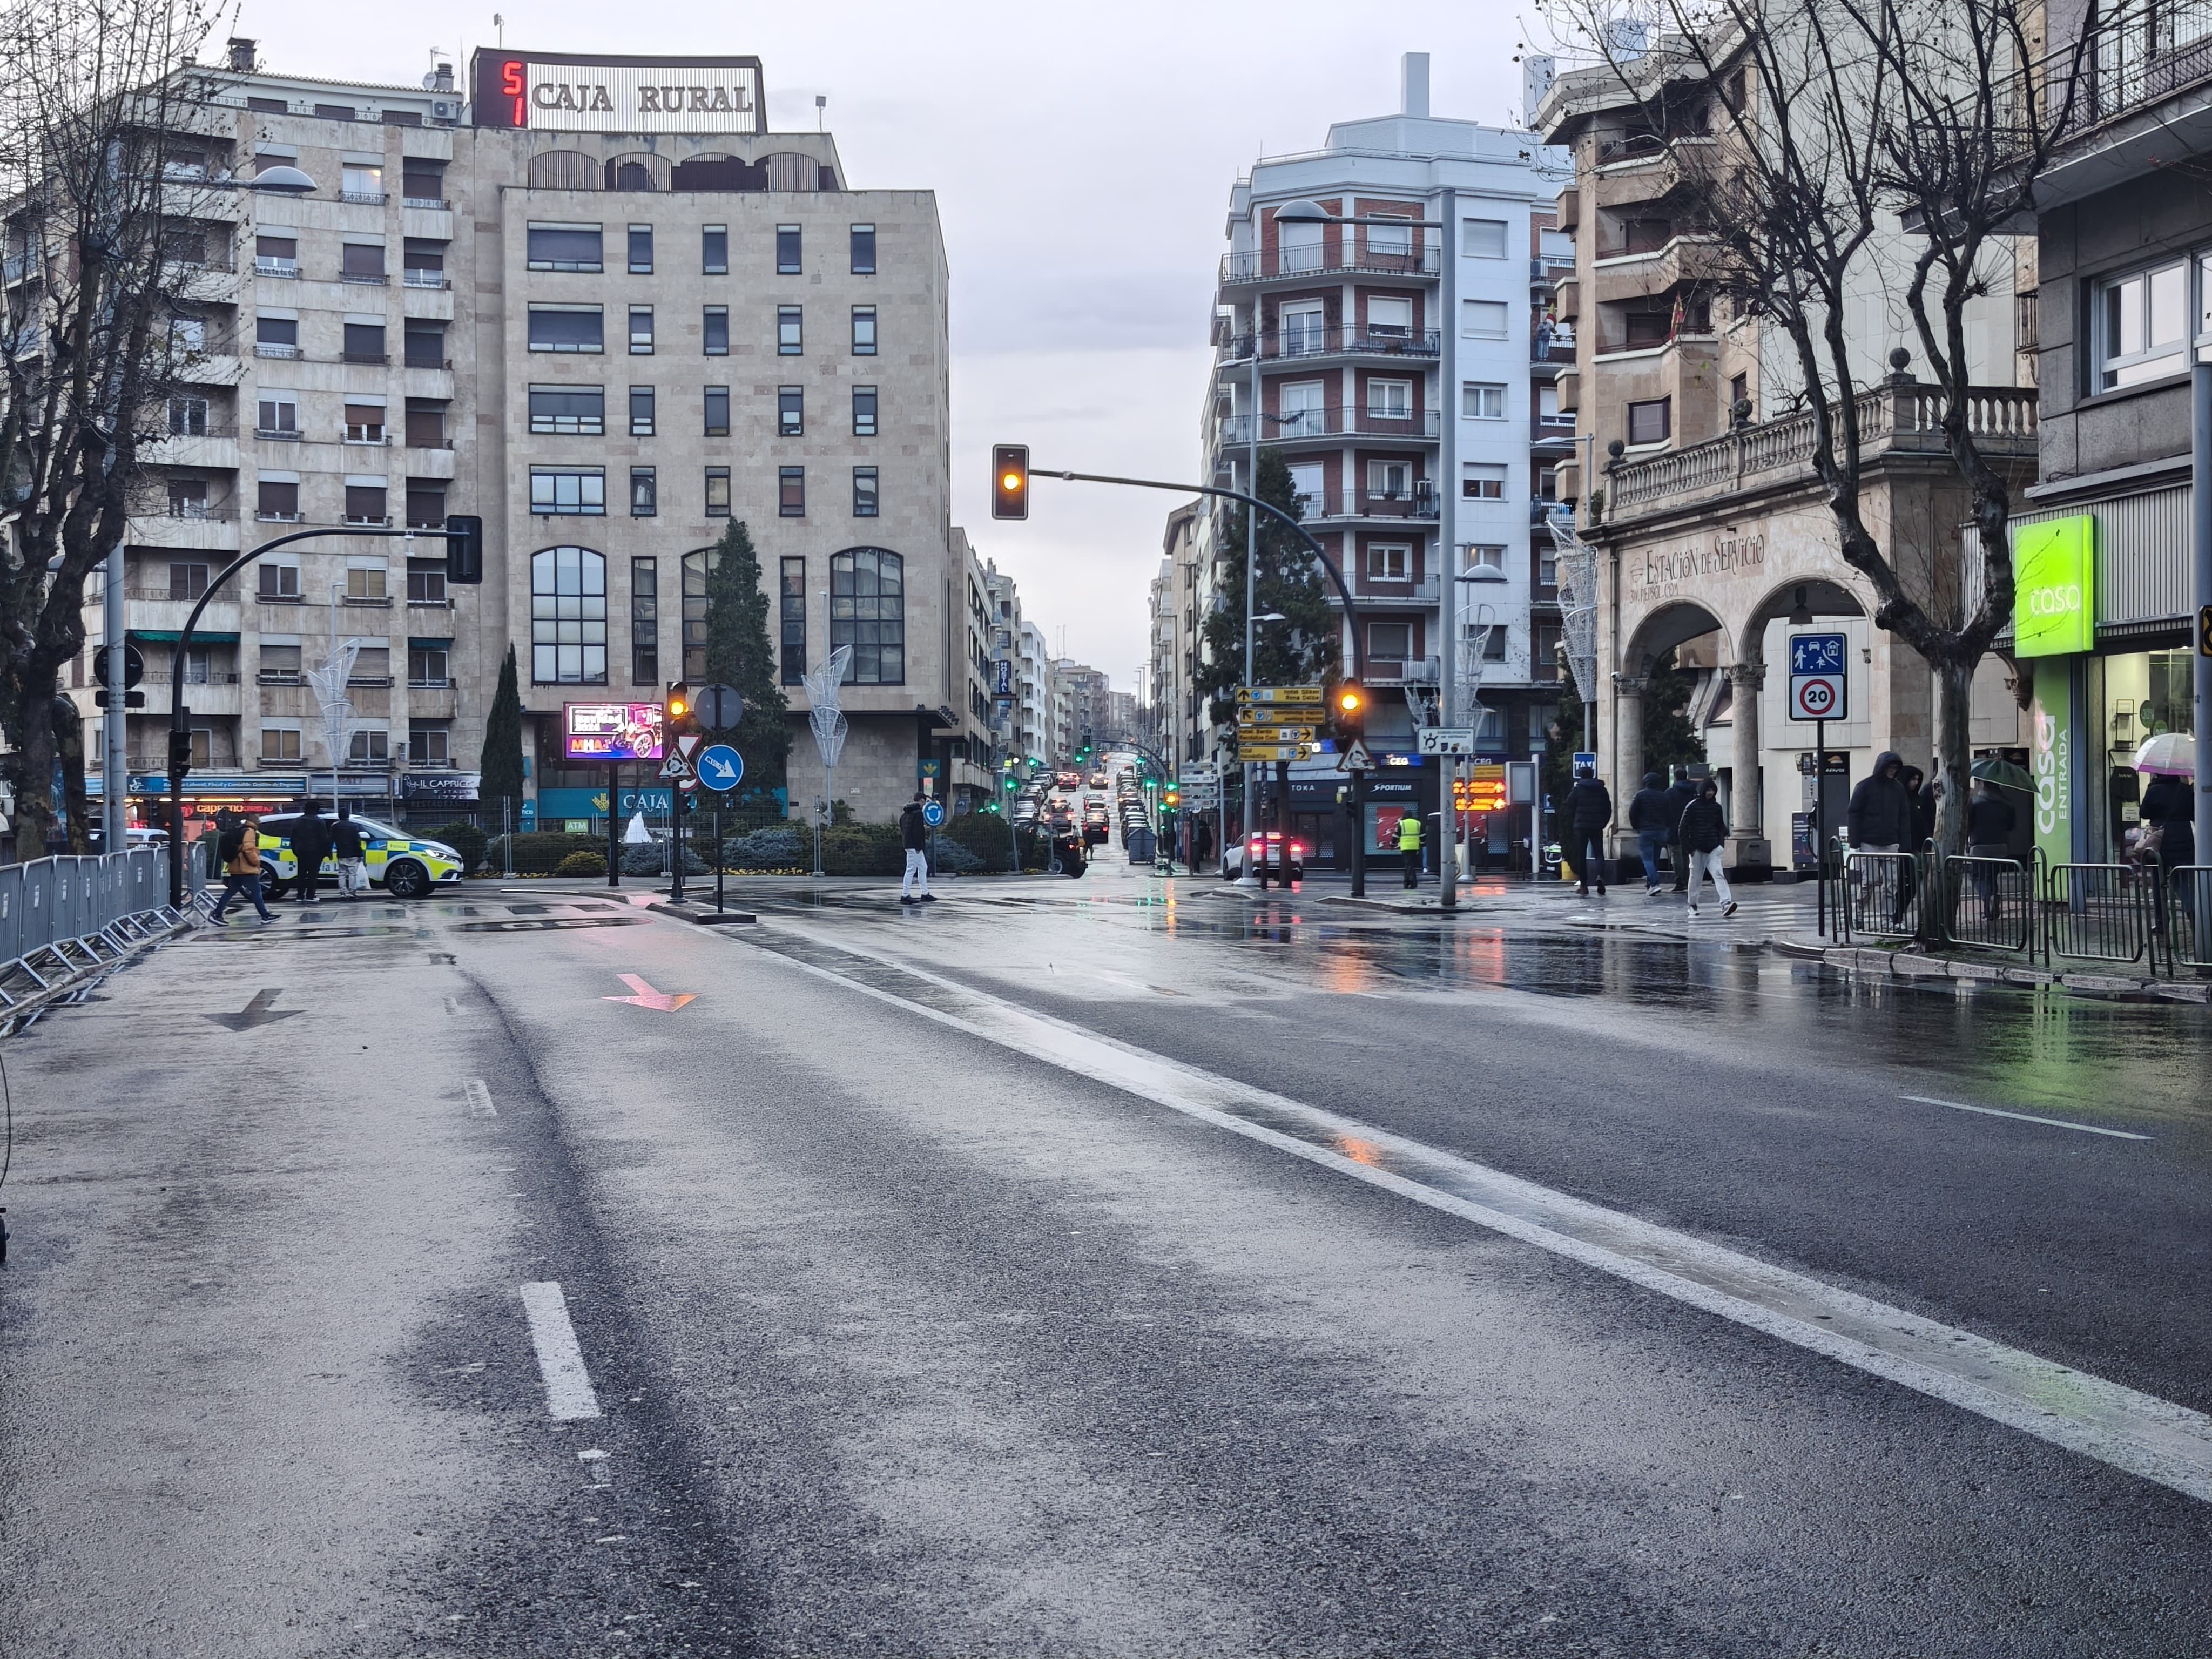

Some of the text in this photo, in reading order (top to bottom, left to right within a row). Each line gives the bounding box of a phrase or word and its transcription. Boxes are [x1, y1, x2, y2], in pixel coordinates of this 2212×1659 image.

[532, 83, 754, 113] CAJA RURAL
[1701, 552, 1711, 575] DE
[2029, 583, 2081, 616] casa
[1808, 690, 1828, 703] 20
[1390, 757, 1409, 766] CEG
[1574, 761, 1595, 770] TAXI
[2038, 715, 2055, 834] casa
[2059, 729, 2067, 820] ENTRADA
[1370, 783, 1412, 793] SPORTIUM
[623, 794, 670, 813] CAJA
[567, 821, 588, 831] ATM
